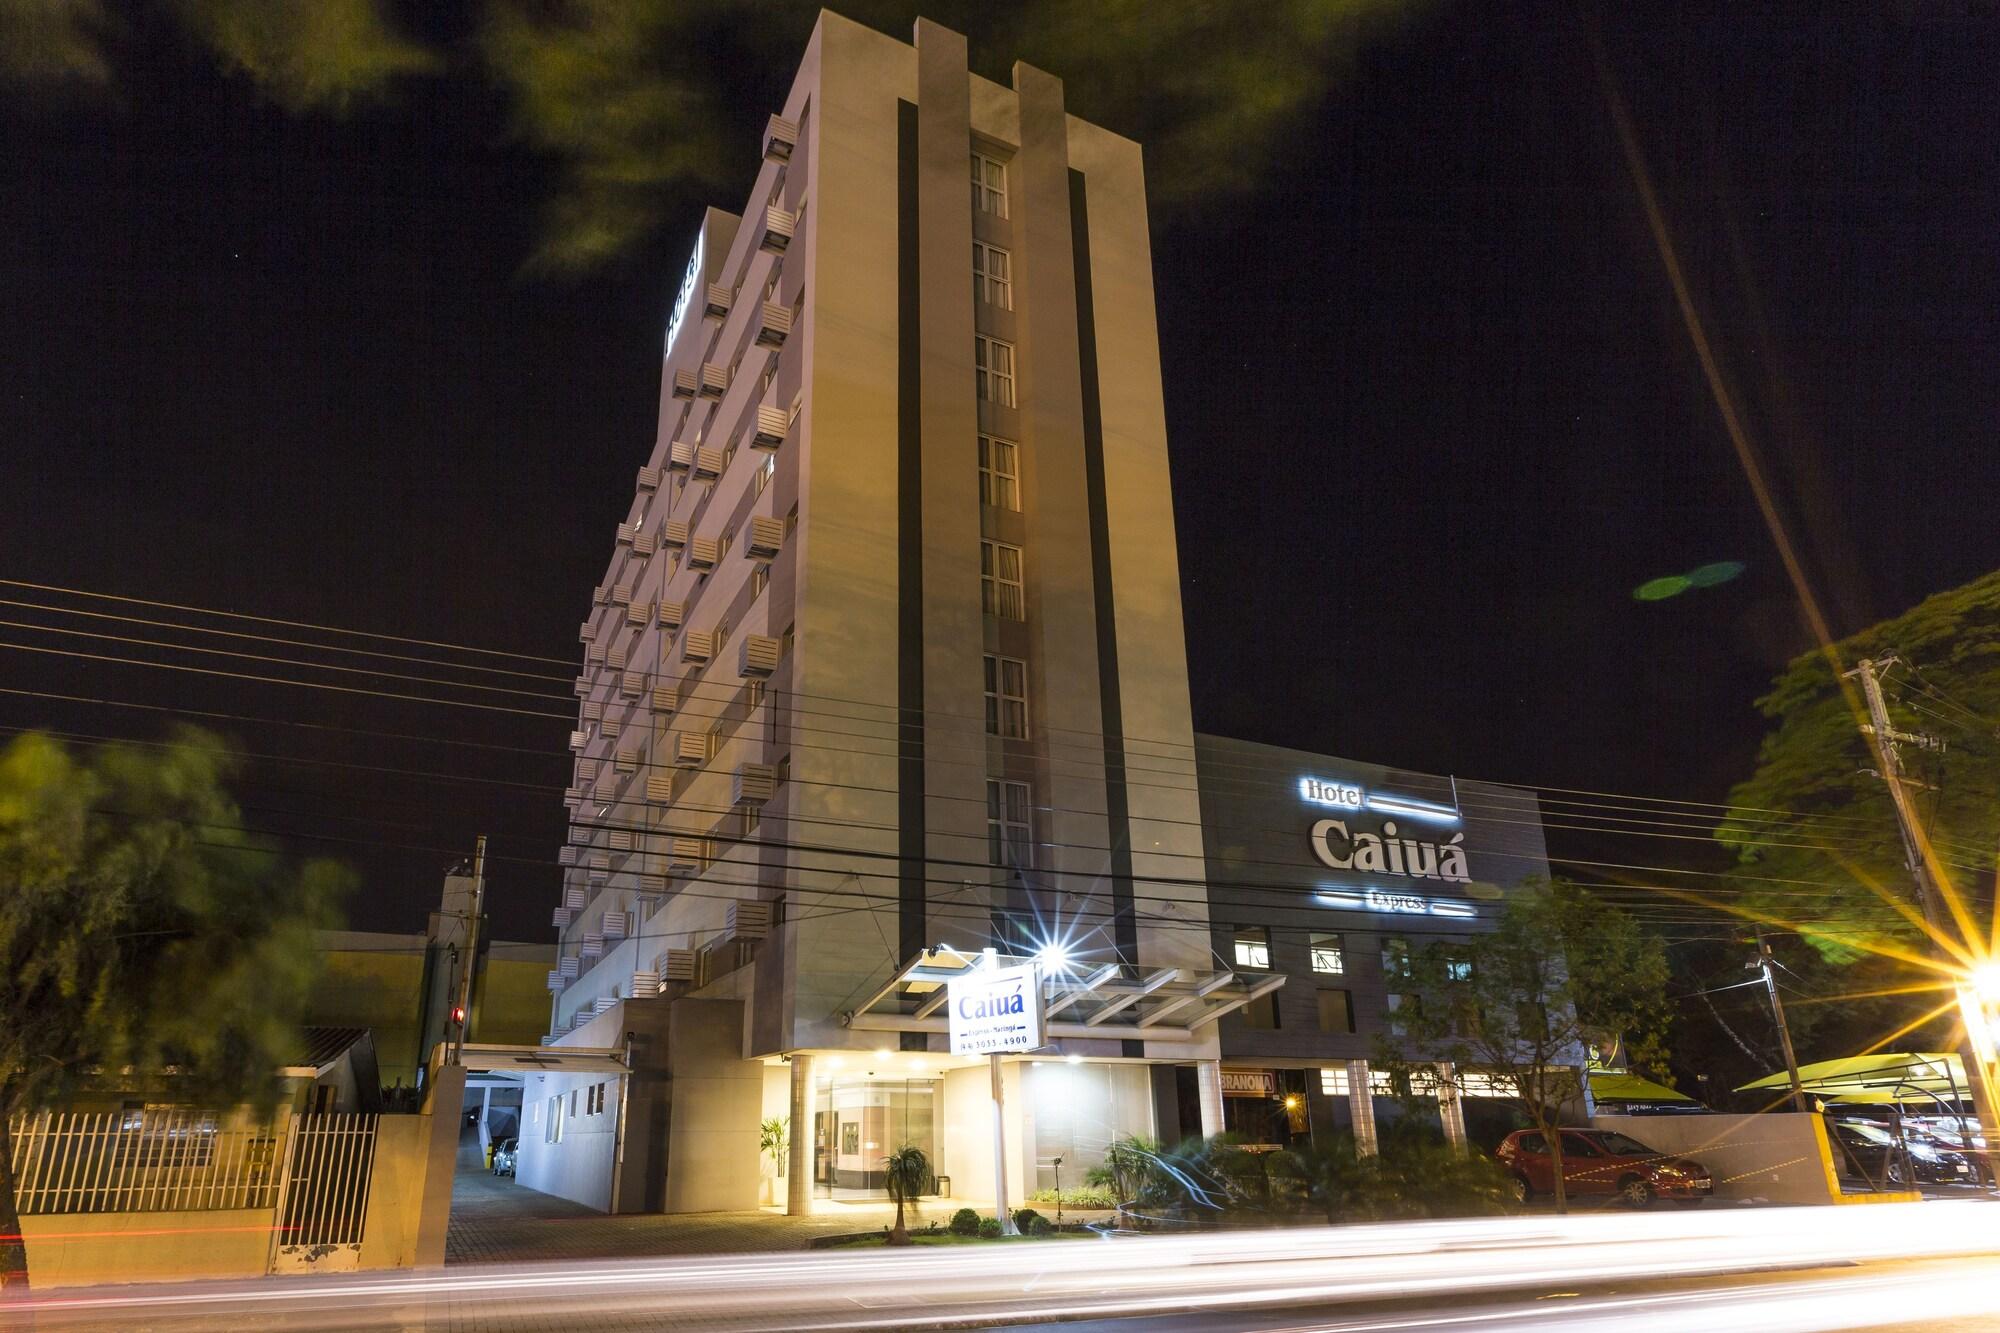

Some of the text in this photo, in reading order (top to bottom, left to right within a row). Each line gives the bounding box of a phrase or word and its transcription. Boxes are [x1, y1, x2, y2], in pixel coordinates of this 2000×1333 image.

[1307, 779, 1364, 807] Hotel
[1310, 819, 1473, 884] Caiuá
[1371, 892, 1428, 910] Express
[958, 984, 1025, 1020] Caiuá
